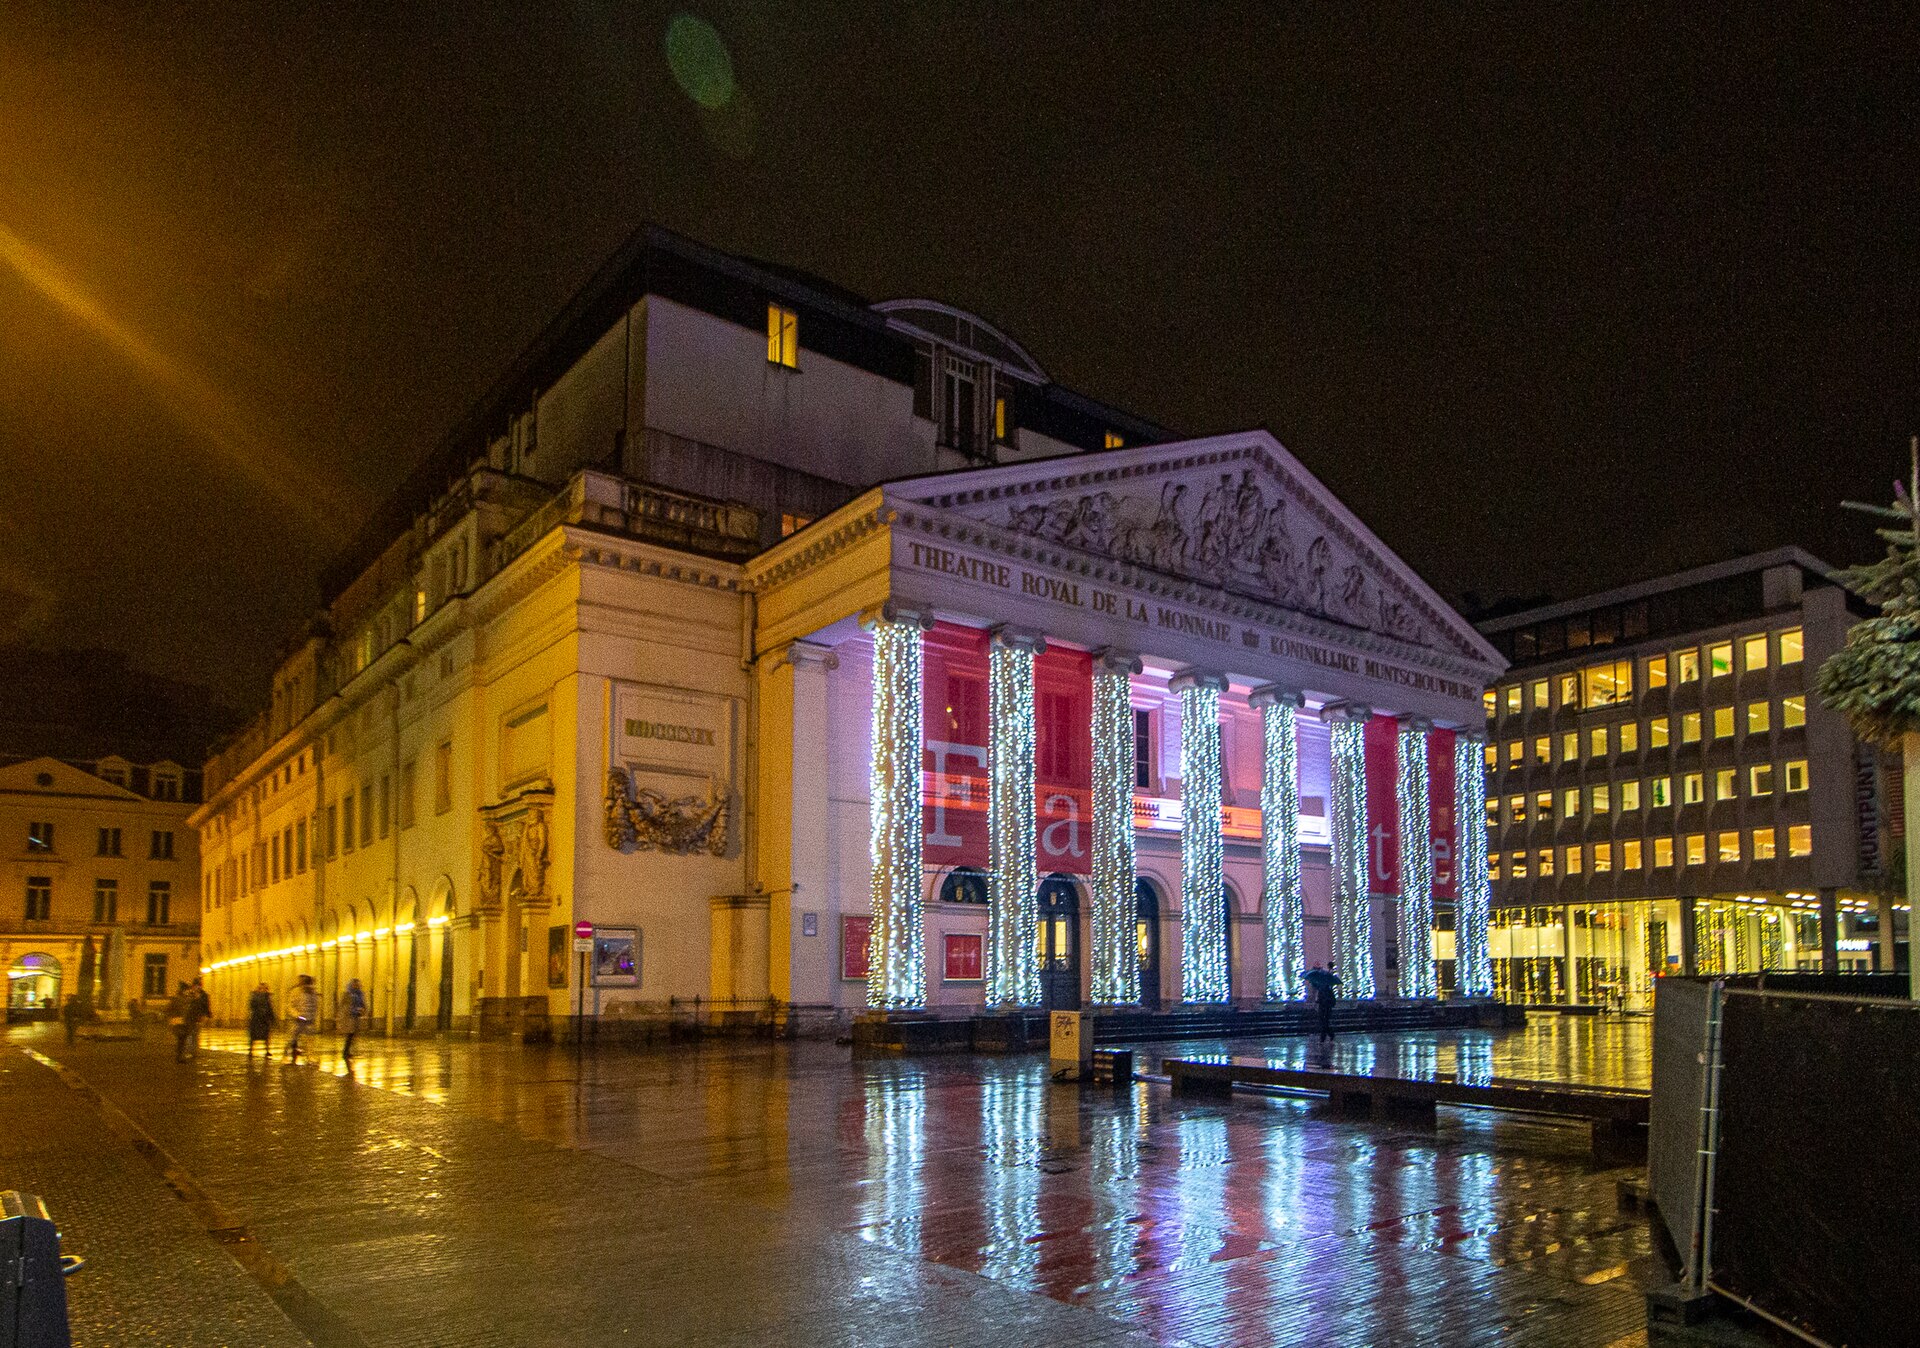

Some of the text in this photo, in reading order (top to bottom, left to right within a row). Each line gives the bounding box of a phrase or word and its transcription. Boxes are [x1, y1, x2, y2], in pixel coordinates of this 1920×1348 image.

[909, 541, 1011, 589] THEATRE
[1021, 570, 1084, 607] ROYAL
[1092, 589, 1118, 616] DE
[1126, 598, 1150, 624] LA
[1157, 607, 1231, 643] MONNAIE
[1270, 635, 1360, 674] KONINKLIJKE
[1857, 761, 1878, 870] MUNTPUNT
